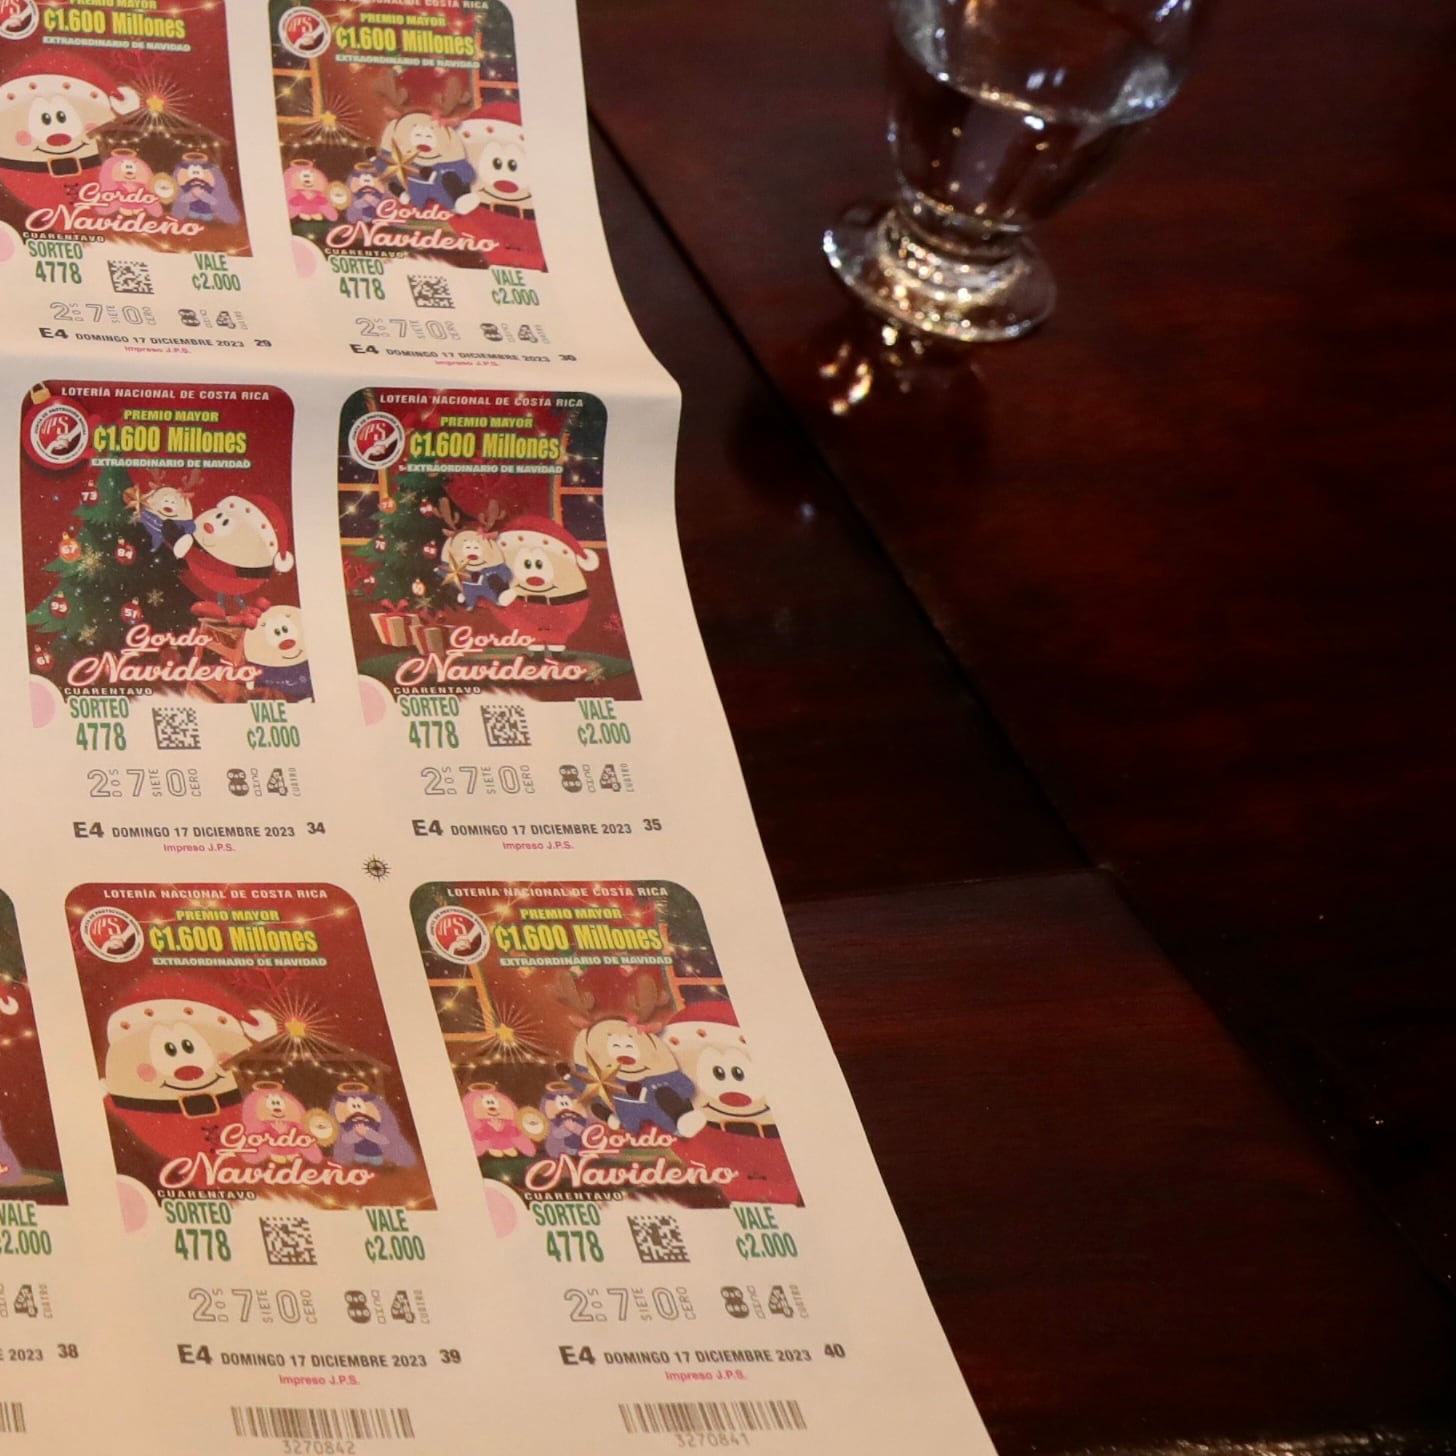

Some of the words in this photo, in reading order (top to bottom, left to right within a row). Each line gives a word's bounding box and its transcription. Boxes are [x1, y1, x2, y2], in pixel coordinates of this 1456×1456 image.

[401, 30, 475, 55] Millones
[26, 240, 85, 260] SORTEO
[32, 260, 83, 286] 4778
[578, 700, 616, 719] VALE
[163, 844, 205, 853] Impreso
[175, 911, 231, 921] PREMIO
[231, 911, 279, 920] MAYOR
[558, 1346, 598, 1365] E4
[602, 1352, 671, 1365] DOMINGO
[674, 1352, 693, 1363] 17
[695, 1350, 774, 1363] DICIEMBRE
[776, 1350, 812, 1361] 2023
[825, 1344, 845, 1358] 40
[279, 1375, 326, 1387] Impreso
